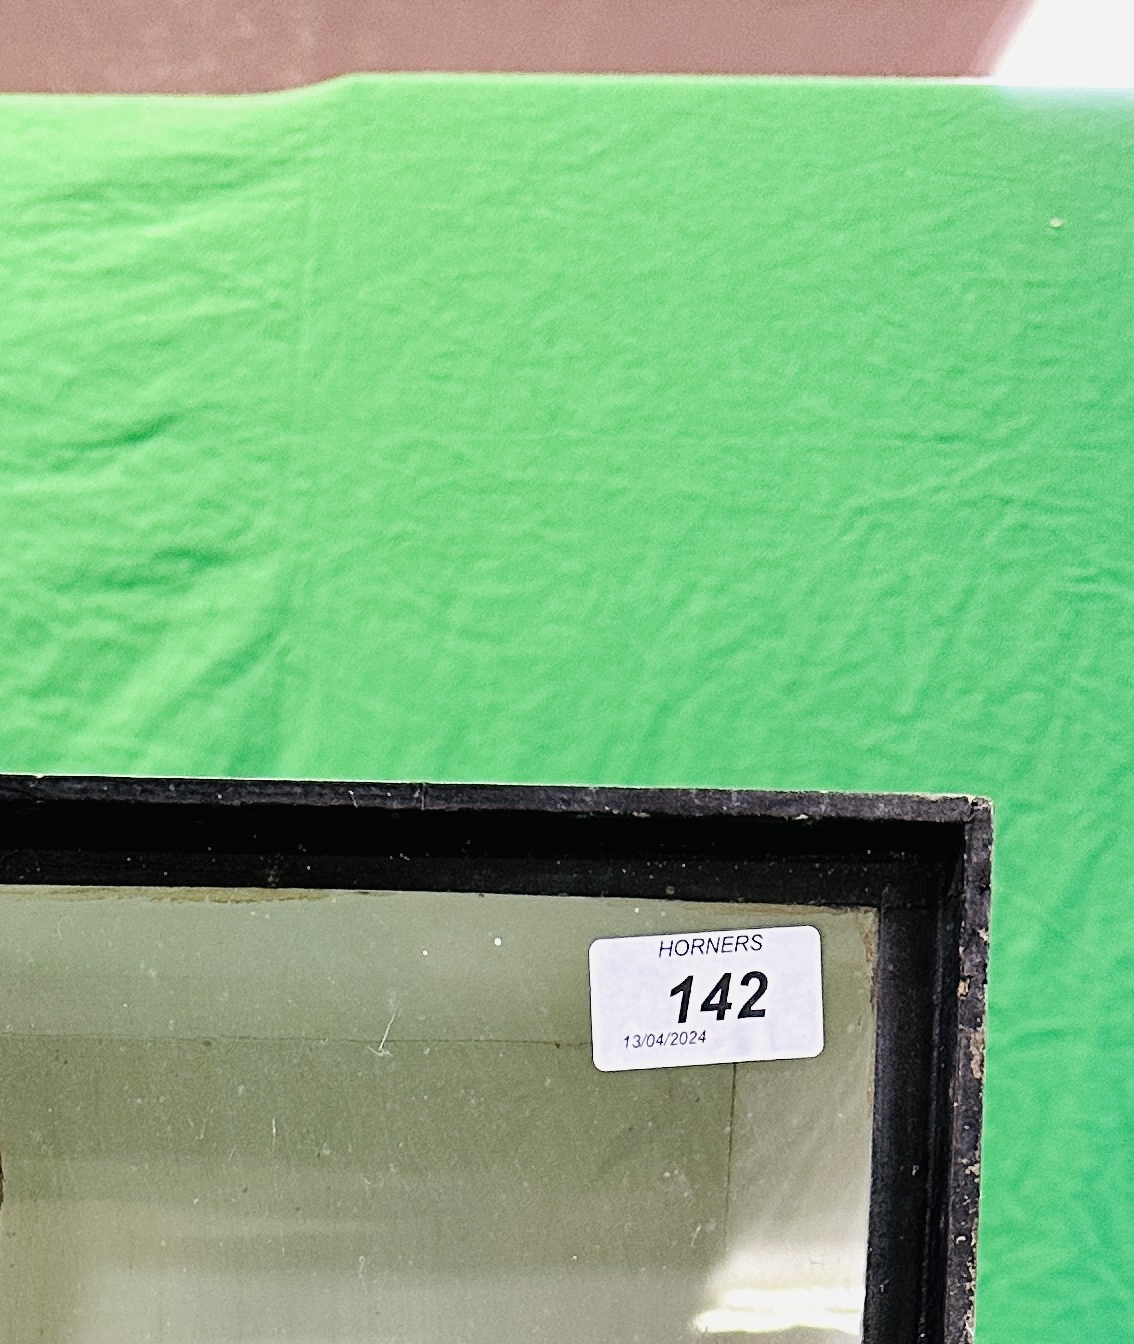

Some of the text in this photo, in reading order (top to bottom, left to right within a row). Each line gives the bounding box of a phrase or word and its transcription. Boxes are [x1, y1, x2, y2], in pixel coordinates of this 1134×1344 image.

[659, 934, 763, 958] HORNERS
[670, 971, 768, 1023] 142
[624, 1030, 707, 1049] 13/04/2024
